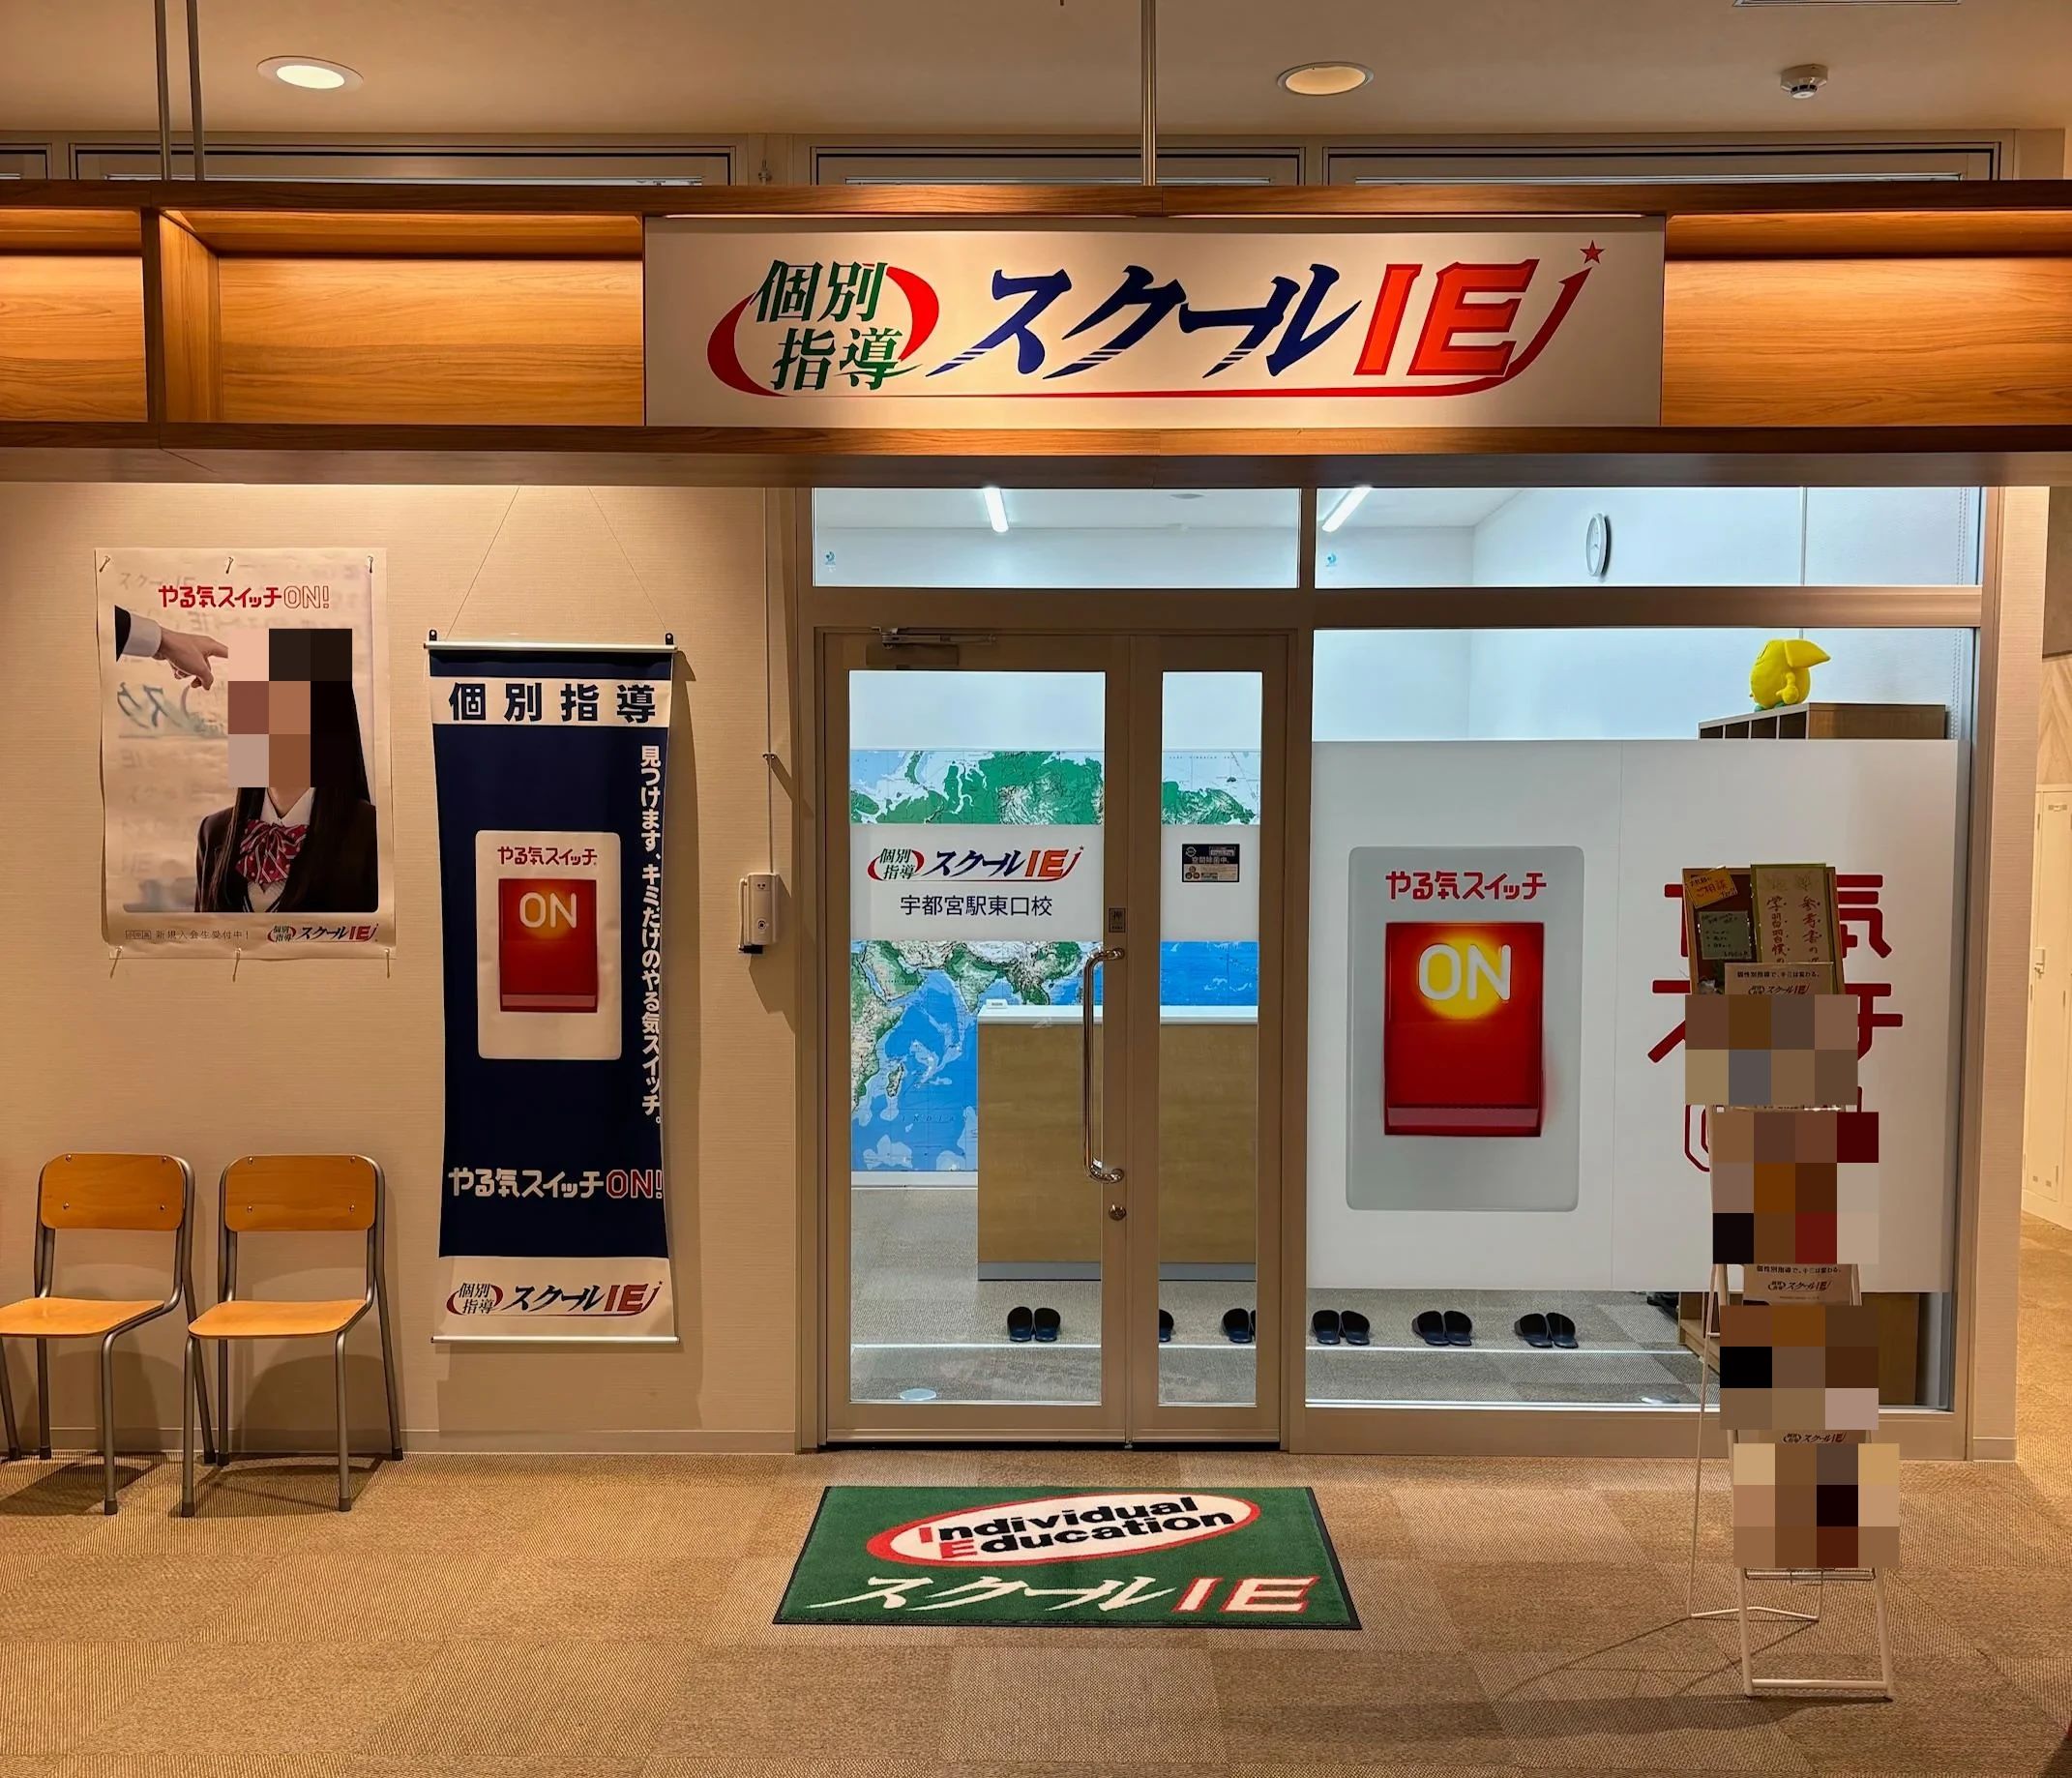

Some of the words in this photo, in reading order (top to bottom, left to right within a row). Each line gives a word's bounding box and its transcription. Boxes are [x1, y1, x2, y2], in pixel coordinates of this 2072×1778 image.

[755, 258, 889, 323] 個別
[924, 257, 1542, 378] スクールIE
[771, 325, 906, 391] 指導
[158, 584, 330, 608] やる気スイッチON!
[448, 681, 656, 724] 個別指導
[497, 845, 597, 866] やる気スイッチ
[879, 848, 910, 864] 個別
[883, 864, 916, 880] 指導
[922, 848, 1071, 879] スクールIE
[1385, 871, 1547, 901] やる気スイッチ
[518, 892, 577, 929] ON
[900, 894, 1053, 917] 宇都宮駅東口校
[640, 744, 662, 1125] 見つけます、キミだけのやる気スイッチ。
[1417, 942, 1511, 1001] ON
[448, 1167, 664, 1200] やる気スイッチON!
[459, 1282, 491, 1298] 個別
[461, 1298, 495, 1315] 指導
[501, 1284, 649, 1313] スクールIE
[919, 1495, 1200, 1545] Individual
[938, 1508, 1235, 1560] Education
[805, 1574, 1320, 1615] スクールIE
